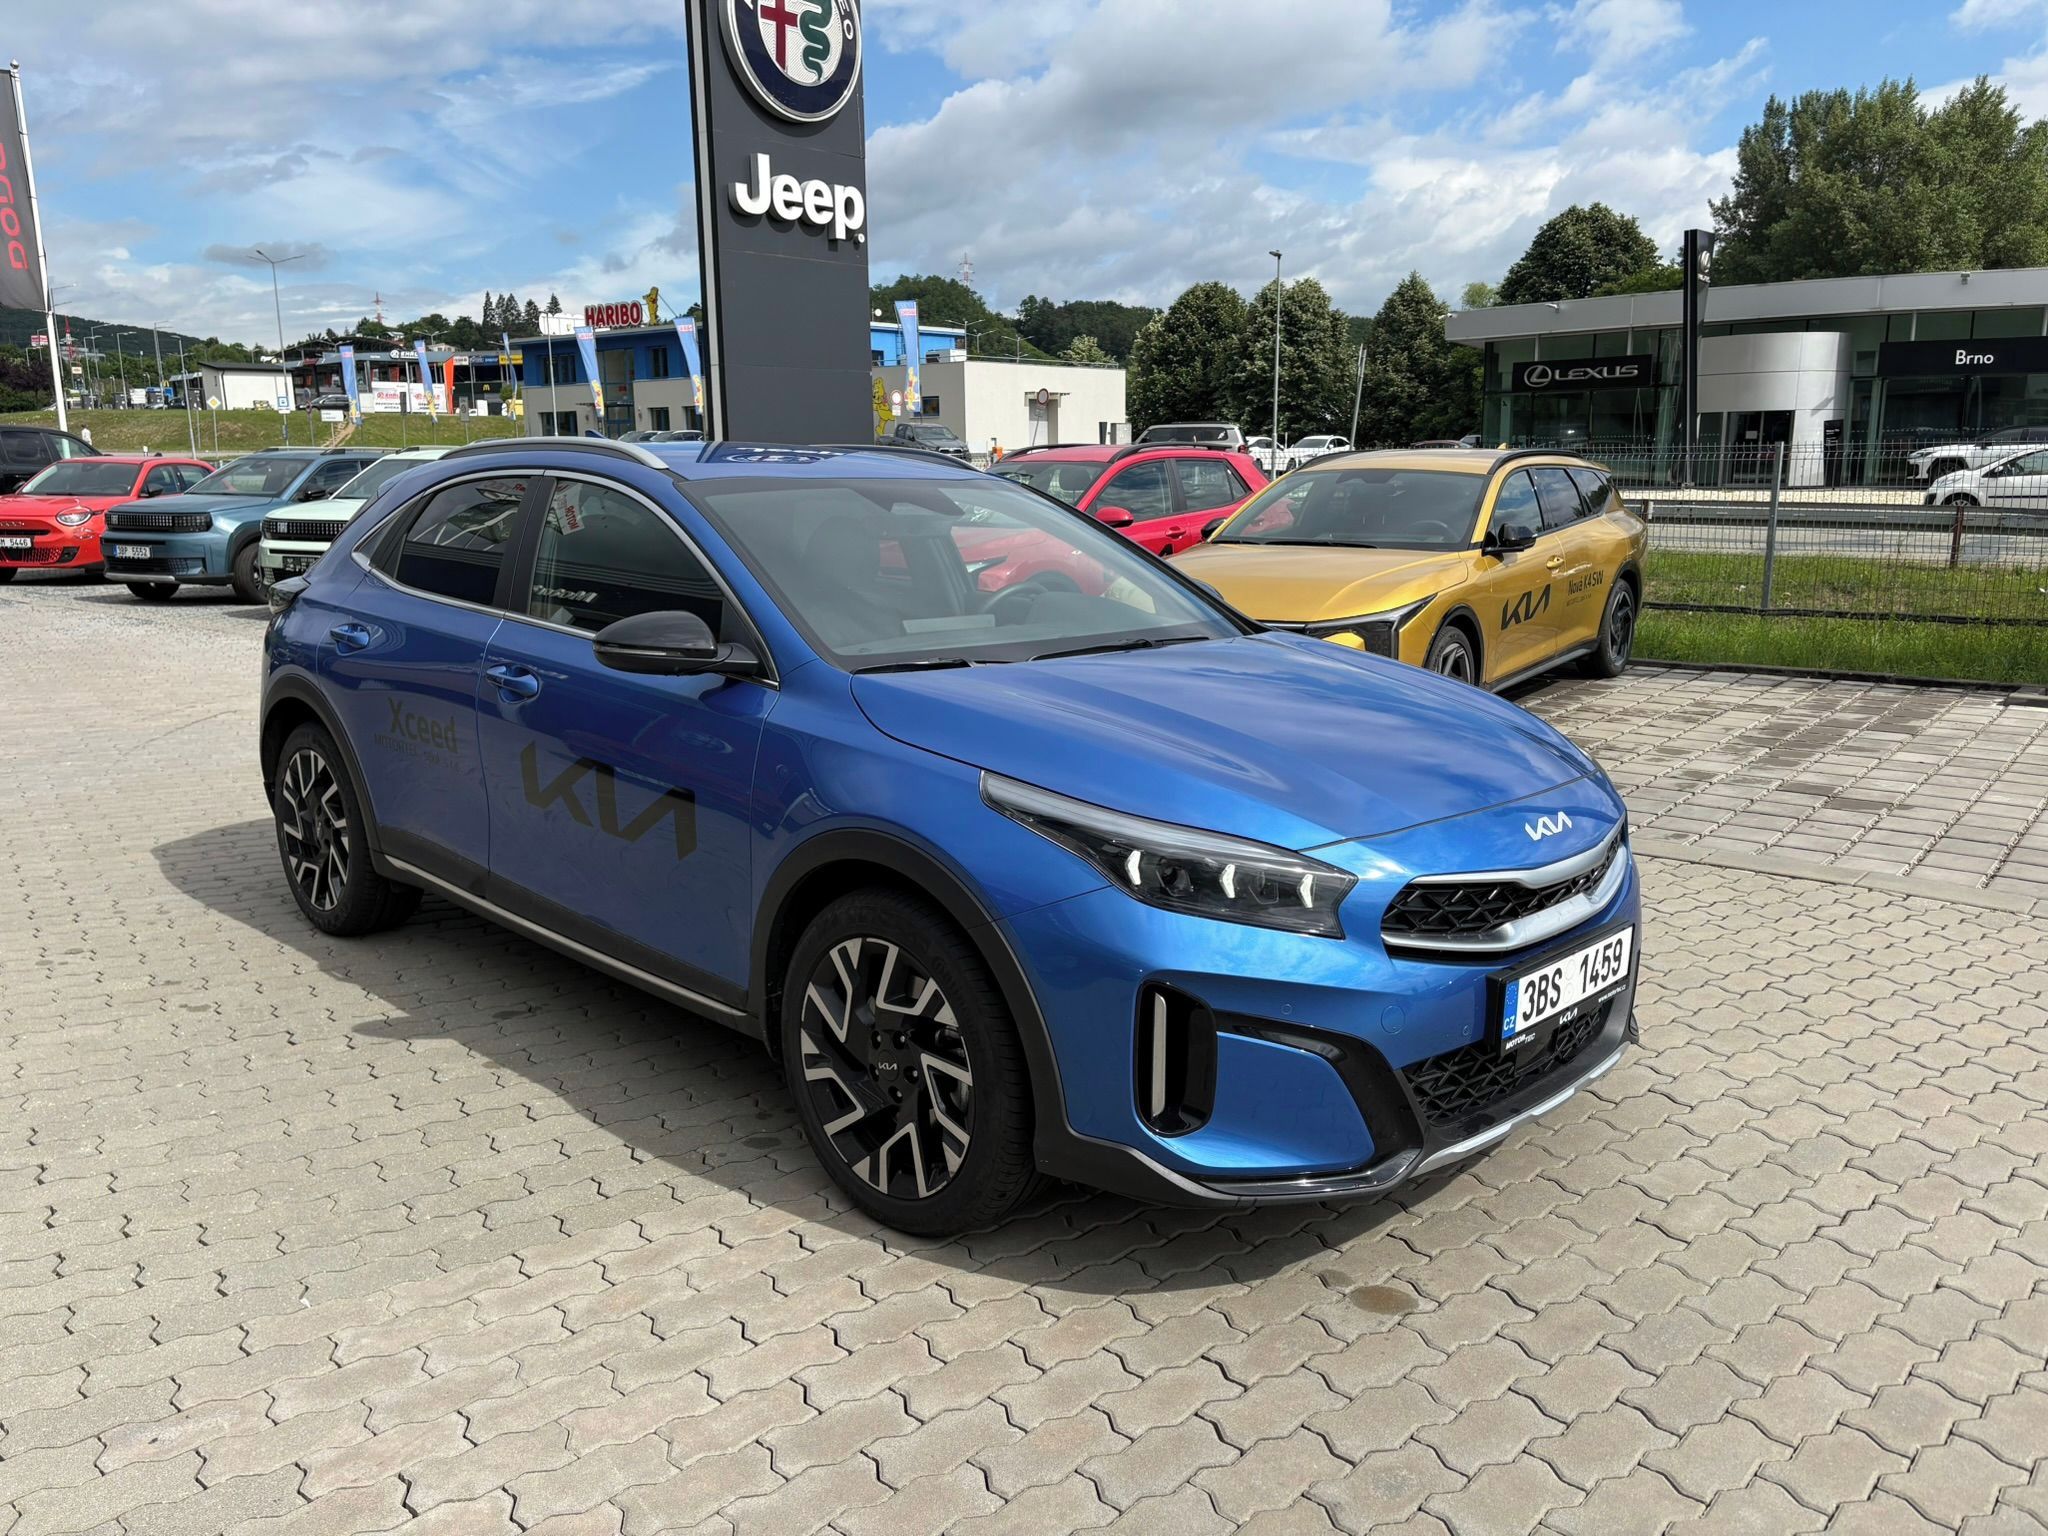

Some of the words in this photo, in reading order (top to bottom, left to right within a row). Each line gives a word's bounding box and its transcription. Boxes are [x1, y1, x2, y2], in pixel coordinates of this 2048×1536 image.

[733, 153, 865, 241] Jeep
[585, 301, 642, 327] HARIBO
[1955, 349, 1994, 364] Brno
[1554, 365, 1639, 380] LEXUS
[1501, 584, 1550, 631] KIA
[387, 697, 458, 754] Xceed
[520, 740, 697, 861] KIA
[1525, 811, 1572, 841] KIA
[1522, 967, 1563, 1022] 3BS
[1580, 938, 1623, 993] 1459
[1503, 1015, 1516, 1030] CZ
[1559, 1007, 1578, 1025] KIA
[878, 1062, 898, 1071] KIA
